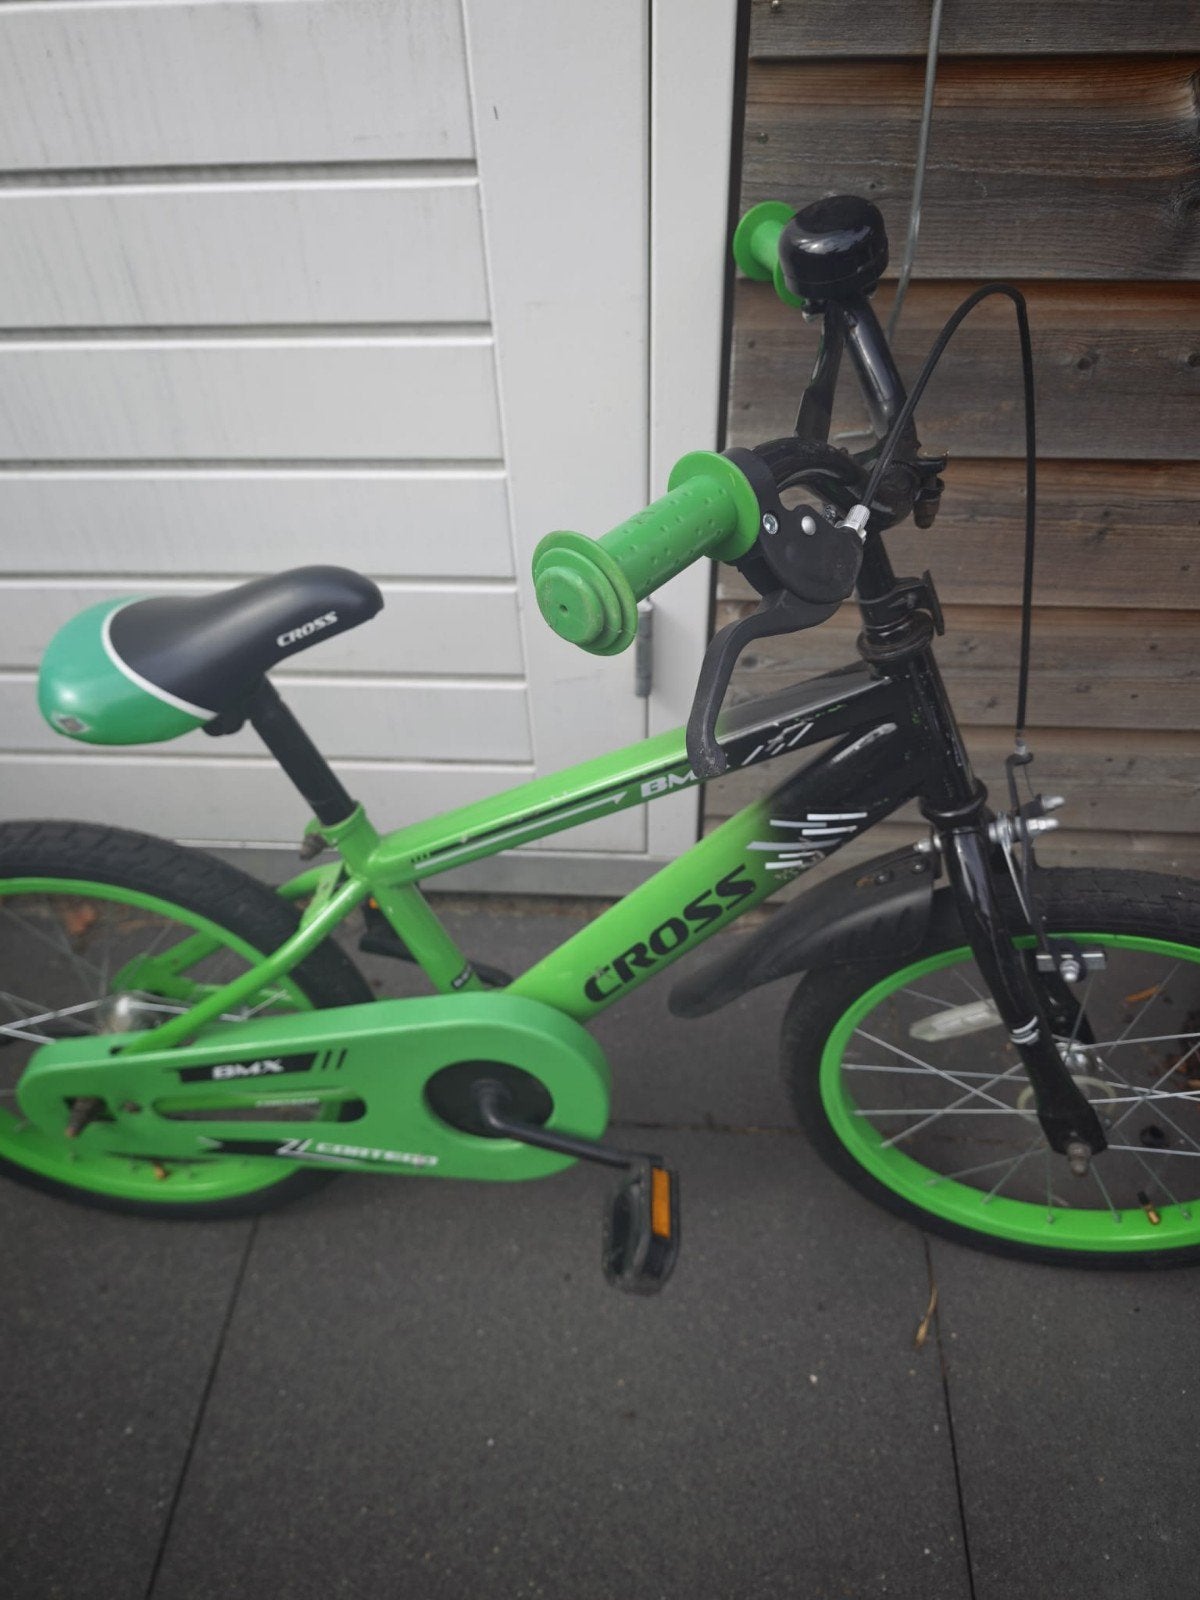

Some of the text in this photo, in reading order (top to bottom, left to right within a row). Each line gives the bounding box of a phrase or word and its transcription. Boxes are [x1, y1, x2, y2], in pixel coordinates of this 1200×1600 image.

[276, 610, 338, 648] CROSS
[640, 768, 702, 798] BM
[584, 863, 756, 1002] CROSS
[212, 1058, 284, 1080] BMX
